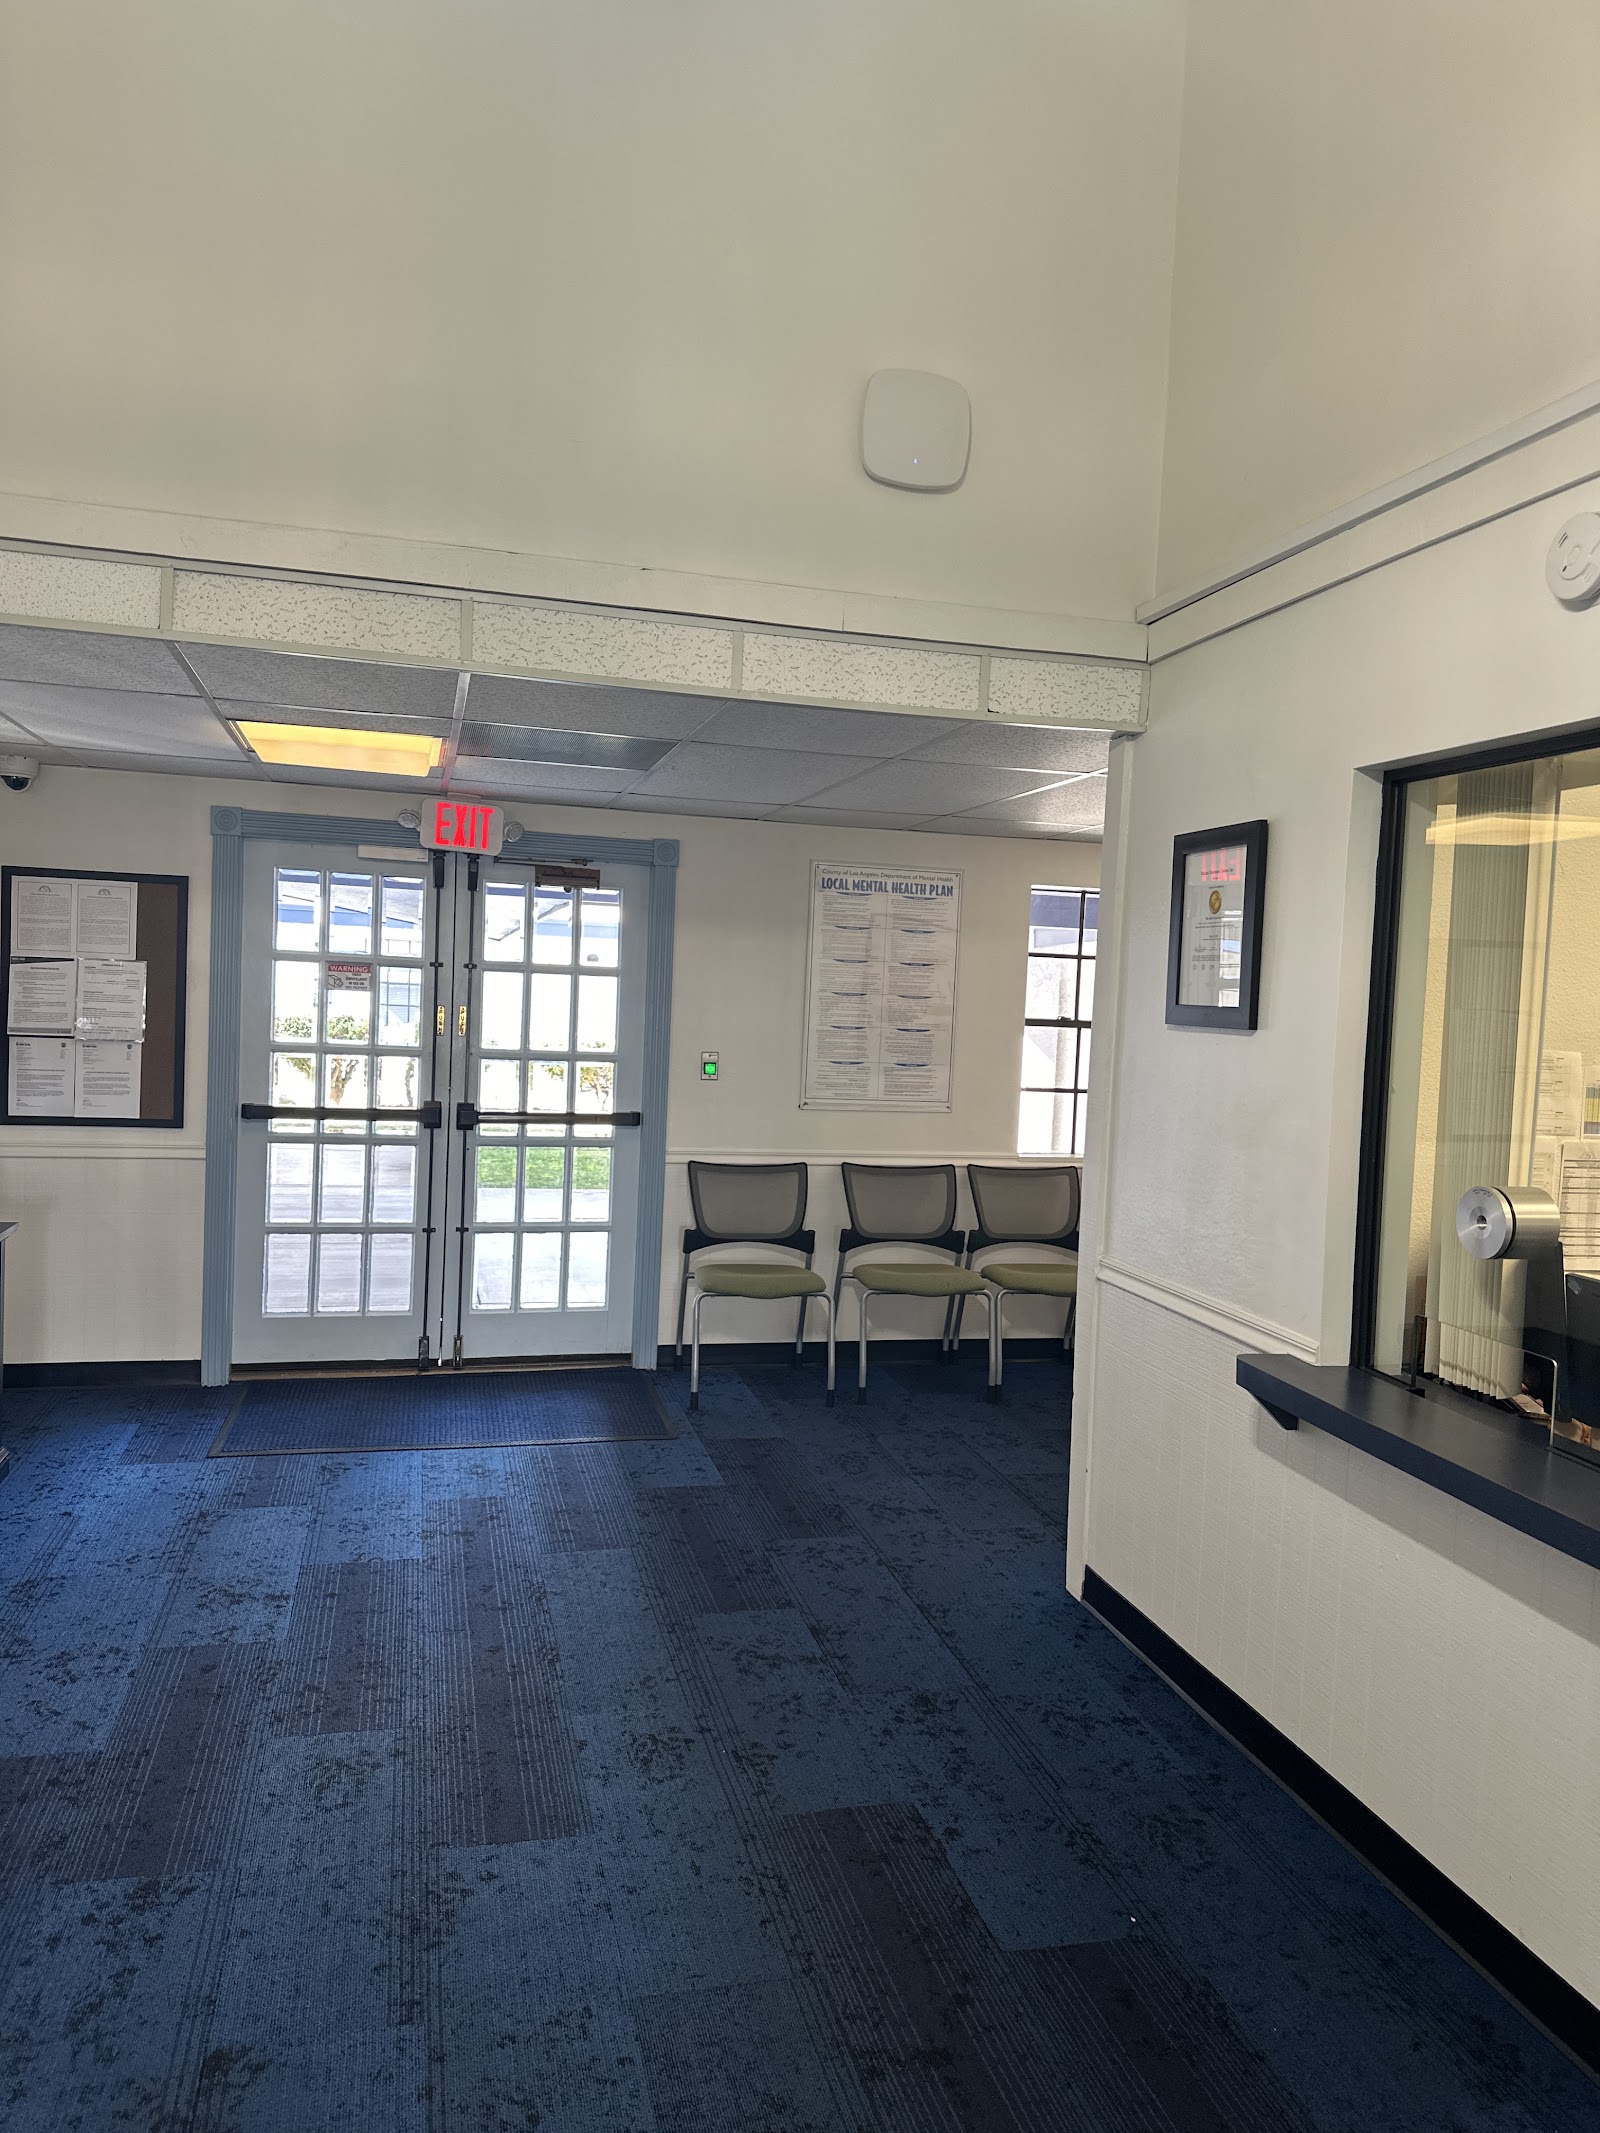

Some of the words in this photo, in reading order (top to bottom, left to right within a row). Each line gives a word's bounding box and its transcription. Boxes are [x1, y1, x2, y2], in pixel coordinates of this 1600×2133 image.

[434, 801, 494, 850] EXIT
[822, 868, 841, 876] County
[881, 872, 911, 880] Department
[937, 875, 953, 883] Health
[822, 877, 849, 890] LOCAL
[852, 879, 889, 893] MENTAL
[891, 881, 927, 896] HEALTH
[929, 884, 954, 897] PLAN
[330, 965, 369, 973] WARNING
